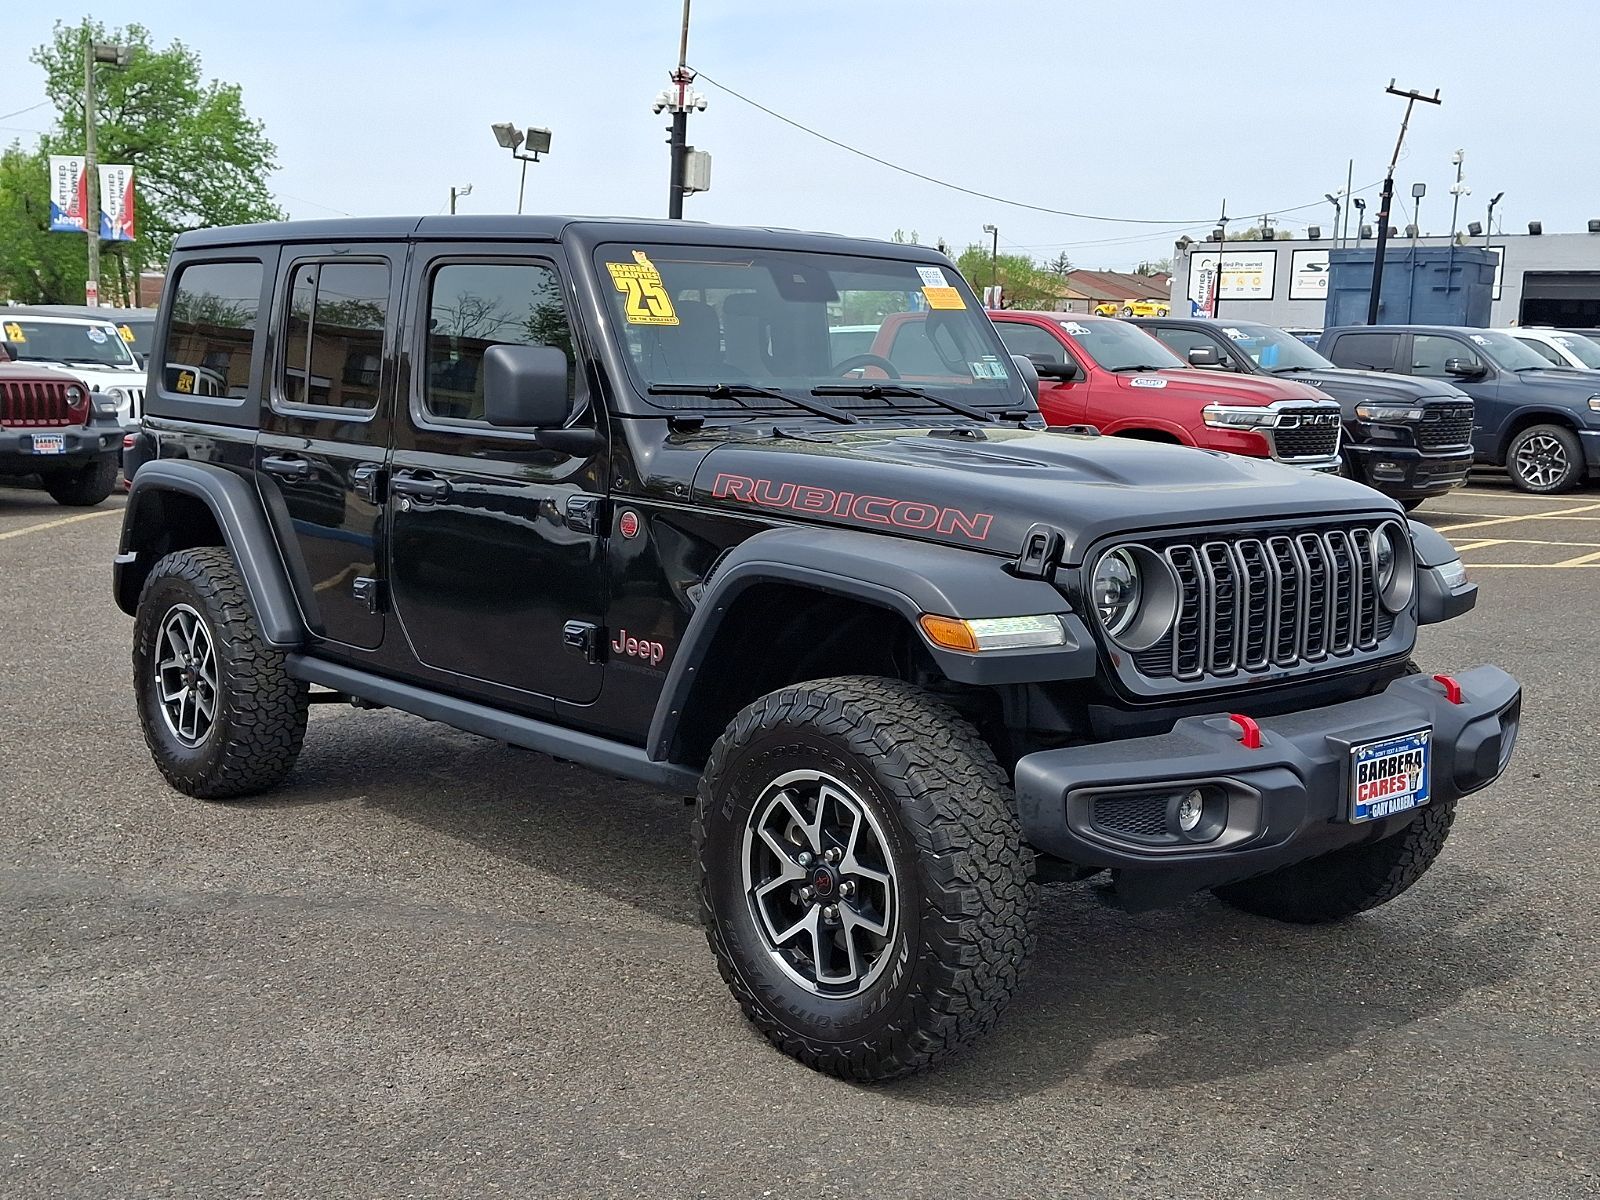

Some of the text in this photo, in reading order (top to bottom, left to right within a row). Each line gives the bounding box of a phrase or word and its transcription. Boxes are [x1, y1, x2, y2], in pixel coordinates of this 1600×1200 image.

[108, 173, 116, 216] CERTIFIED
[54, 214, 84, 227] Jeep
[614, 278, 674, 317] 25
[1193, 309, 1211, 319] Jeep
[712, 472, 994, 541] RUBICON
[612, 629, 665, 667] Jeep
[1358, 751, 1423, 784] BARBERA
[1358, 774, 1408, 802] CARES
[1372, 801, 1389, 817] GARY
